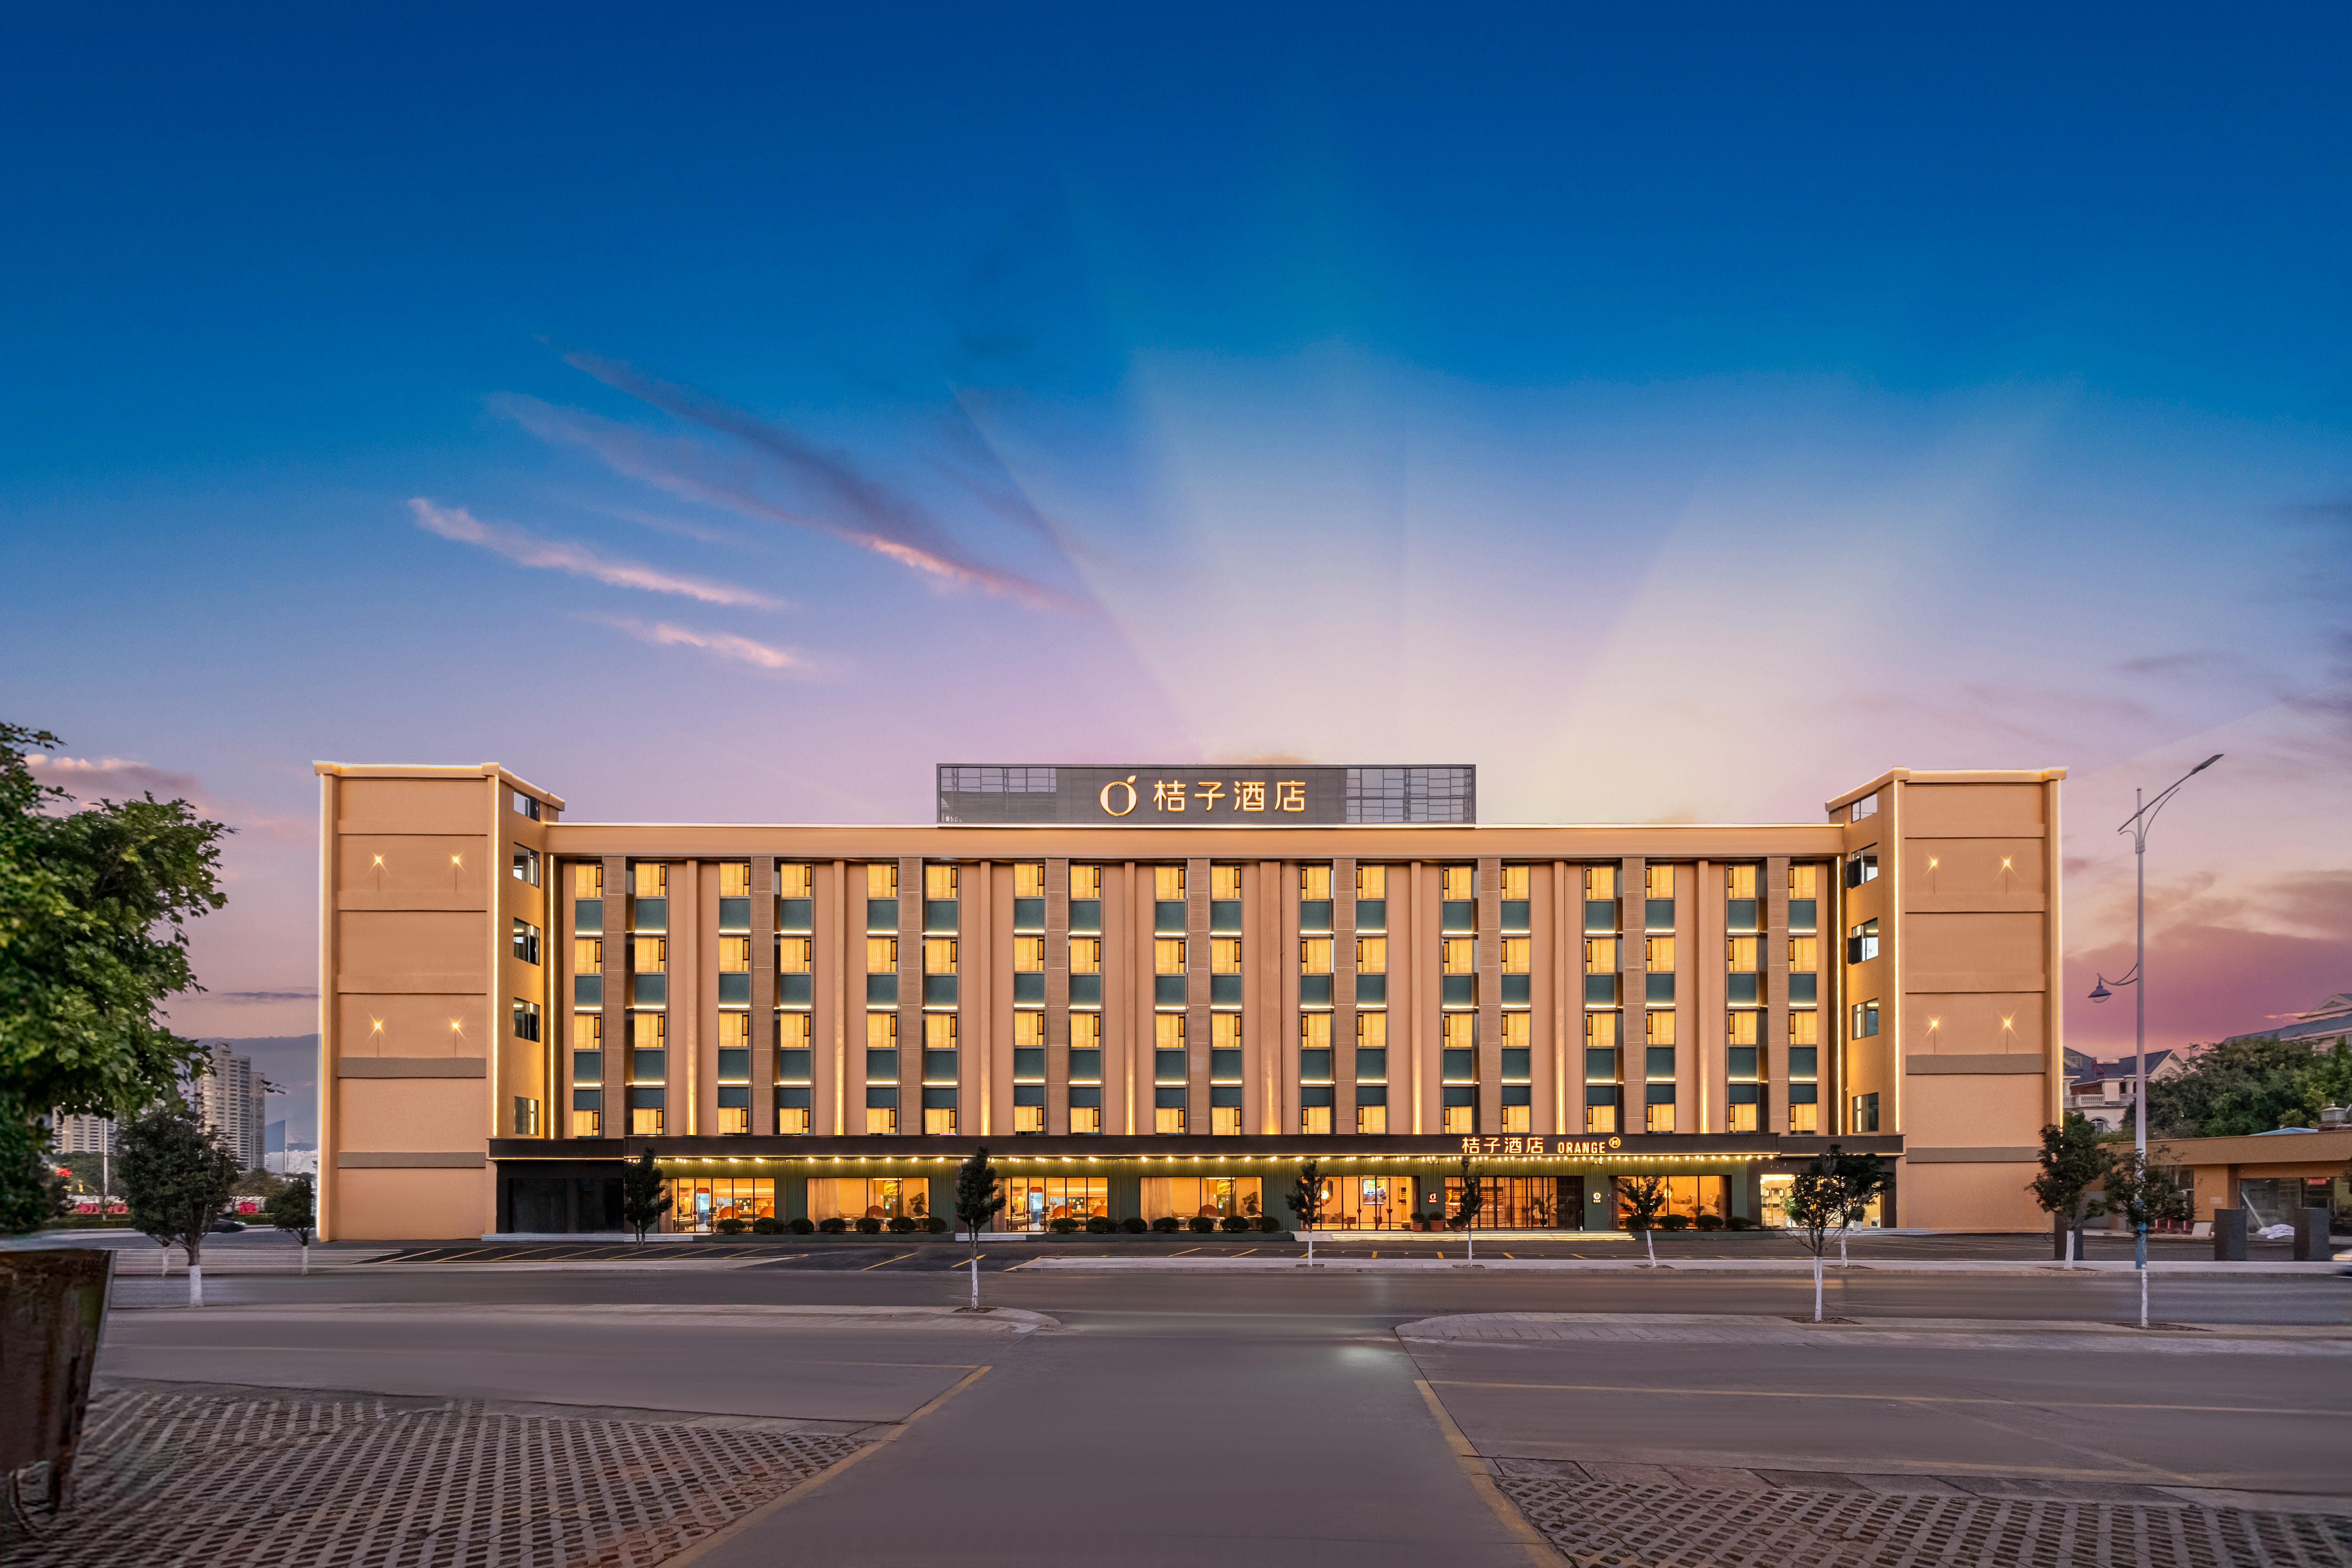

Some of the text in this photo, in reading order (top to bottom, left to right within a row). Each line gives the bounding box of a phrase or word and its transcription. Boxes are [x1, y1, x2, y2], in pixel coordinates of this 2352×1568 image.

[1153, 780, 1306, 812] 桔子酒店
[1462, 1137, 1544, 1154] 桔子酒店
[1558, 1142, 1606, 1154] ORANGE
